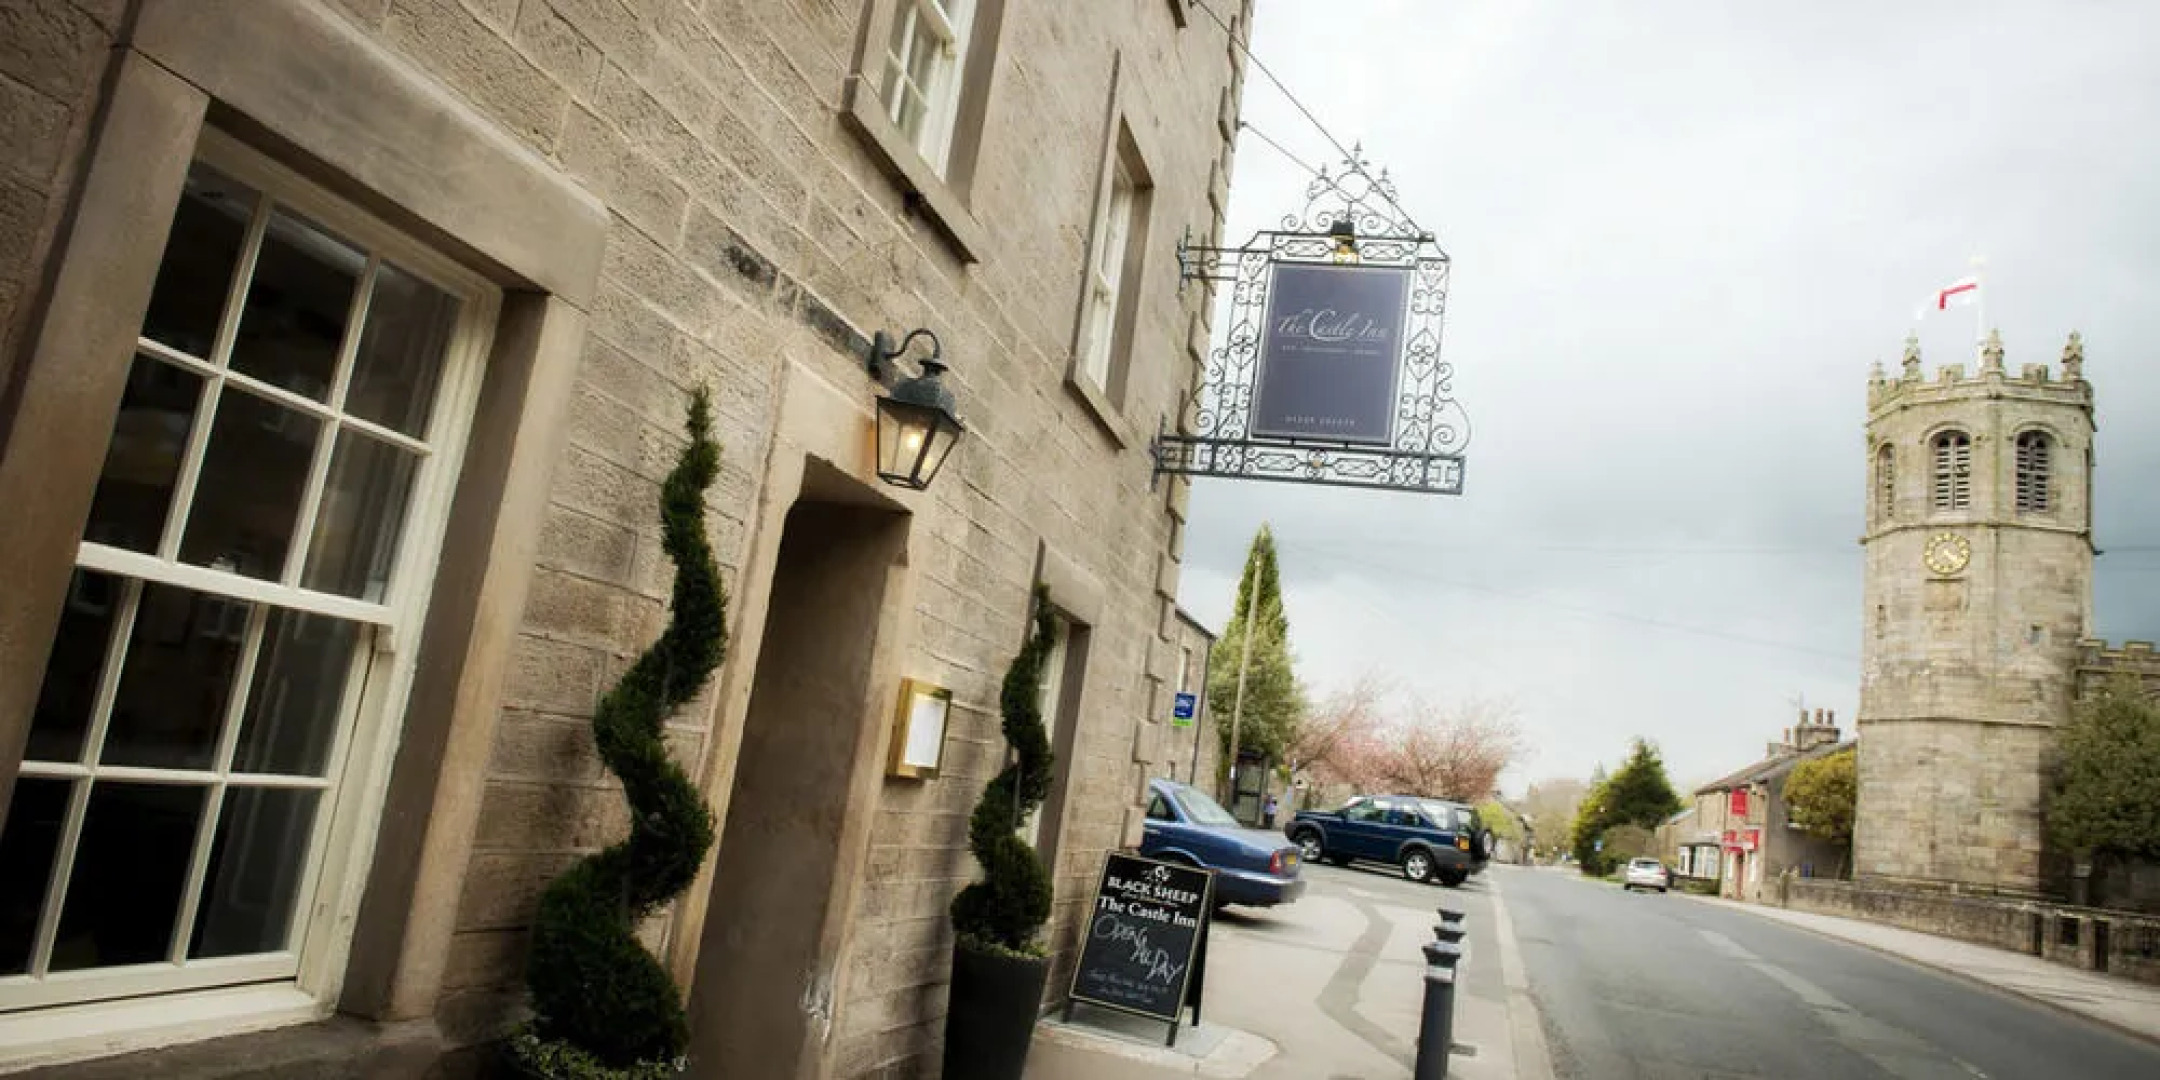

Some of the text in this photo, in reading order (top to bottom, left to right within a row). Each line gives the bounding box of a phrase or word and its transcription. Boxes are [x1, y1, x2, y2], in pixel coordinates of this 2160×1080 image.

[1309, 308, 1359, 341] Castle
[1107, 876, 1150, 895] BLACK
[1154, 886, 1199, 904] SHEEP
[1100, 896, 1126, 913] The
[1128, 902, 1170, 923] Castle
[1173, 911, 1196, 928] Inn
